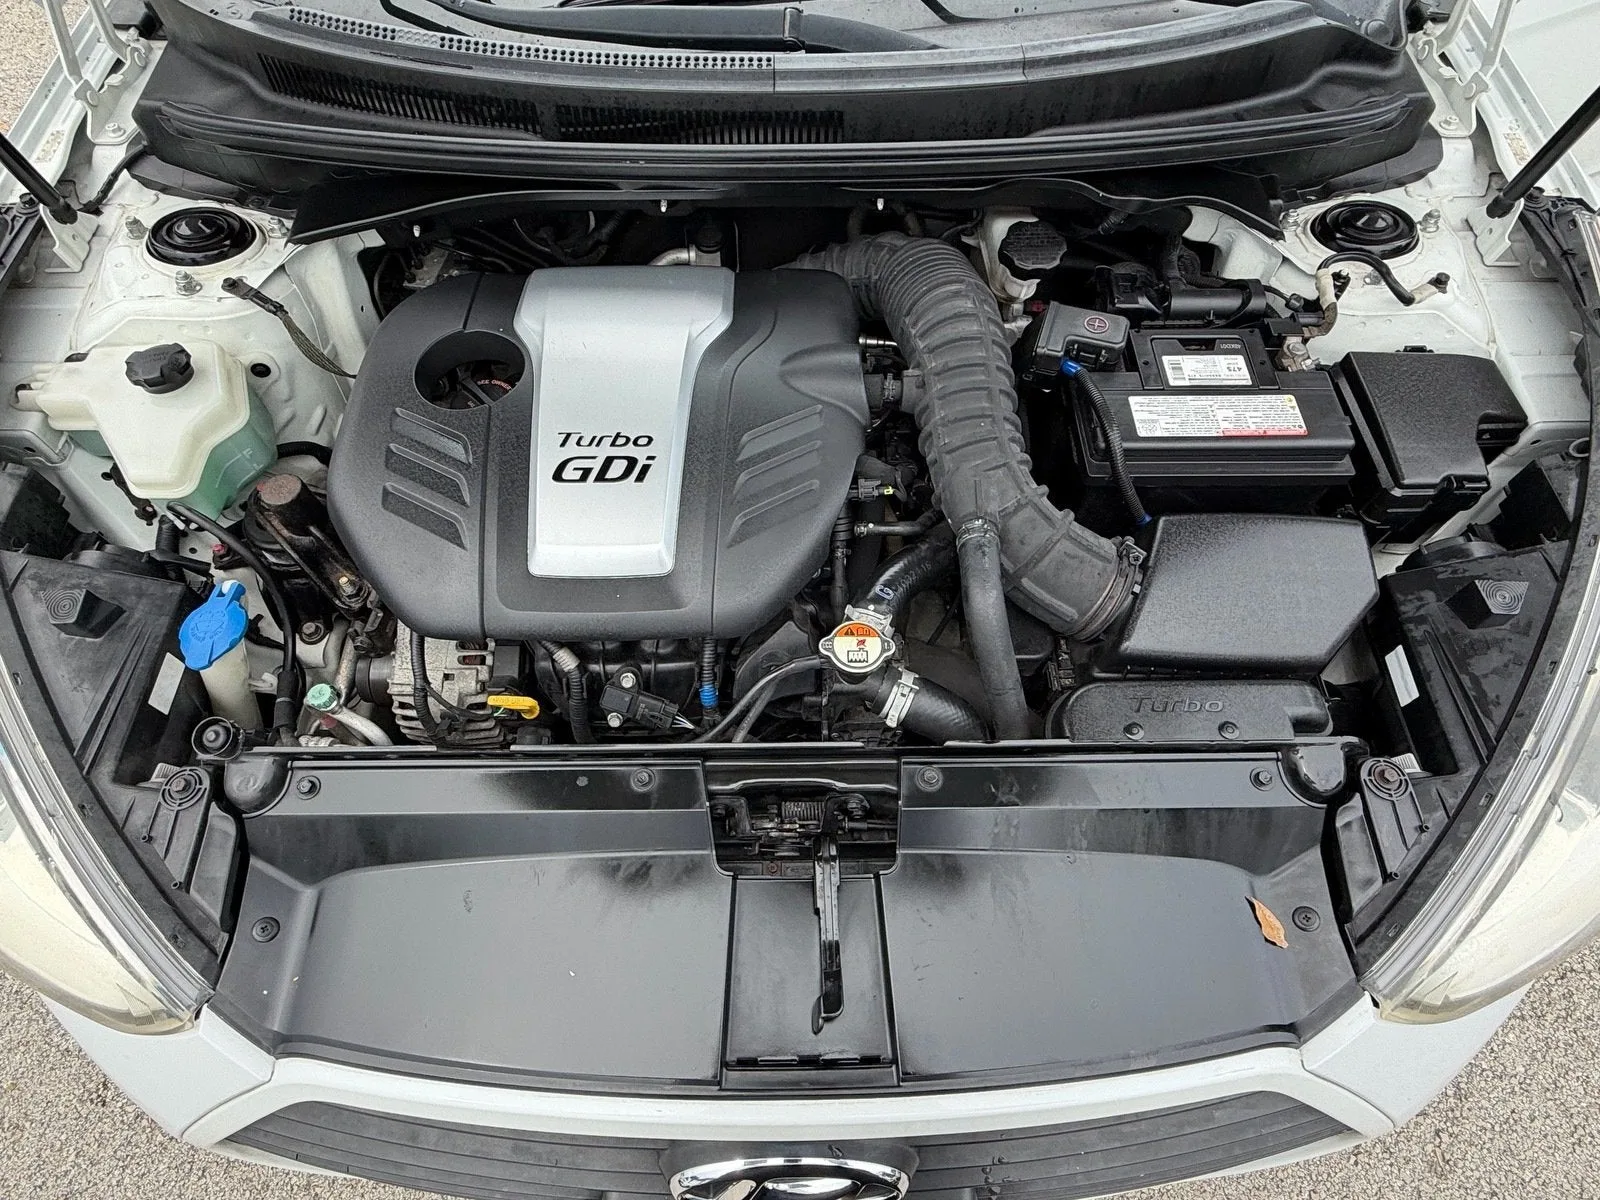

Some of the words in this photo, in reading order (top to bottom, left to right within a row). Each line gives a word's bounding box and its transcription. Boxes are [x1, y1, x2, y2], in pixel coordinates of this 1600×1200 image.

[558, 431, 654, 448] Turbo
[552, 455, 657, 483] GDi
[1129, 696, 1224, 713] Turbo
